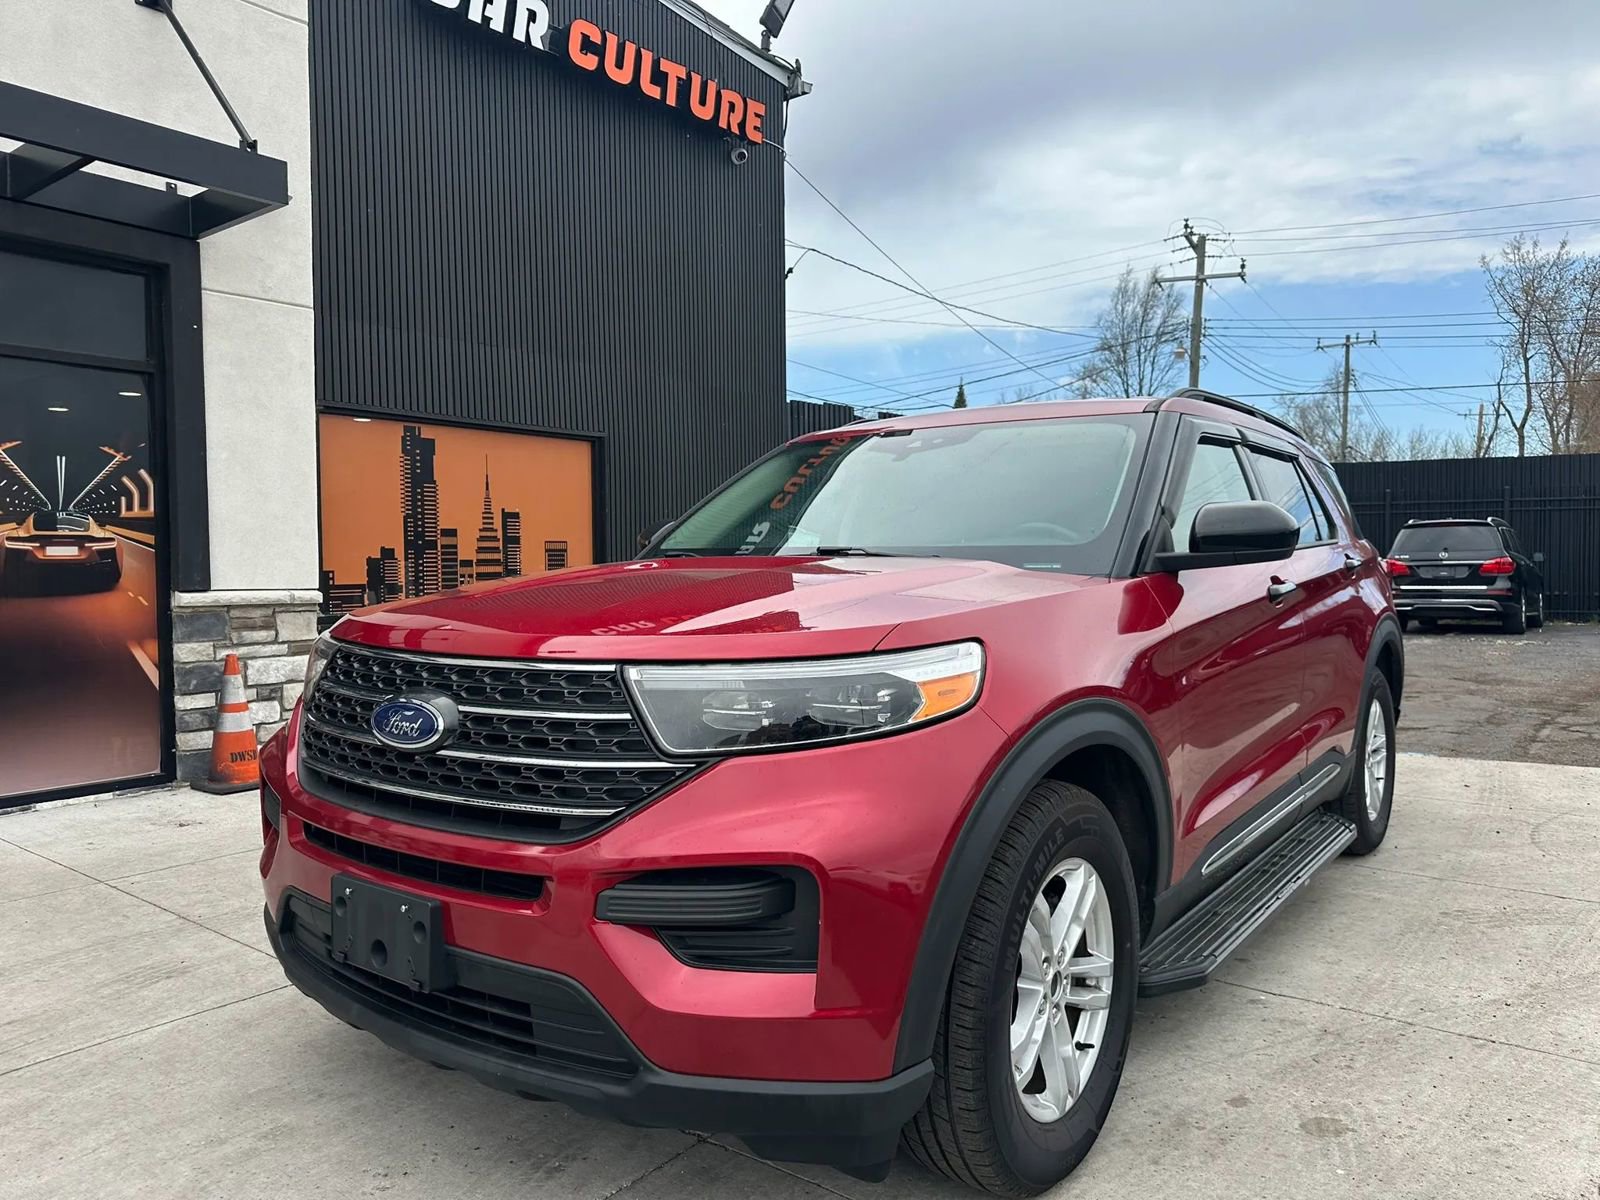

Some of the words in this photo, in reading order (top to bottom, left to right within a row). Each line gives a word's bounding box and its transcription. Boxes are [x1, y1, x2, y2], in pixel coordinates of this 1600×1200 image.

[431, 0, 549, 51] AR
[568, 18, 766, 144] CULTURE
[383, 707, 423, 737] Ford
